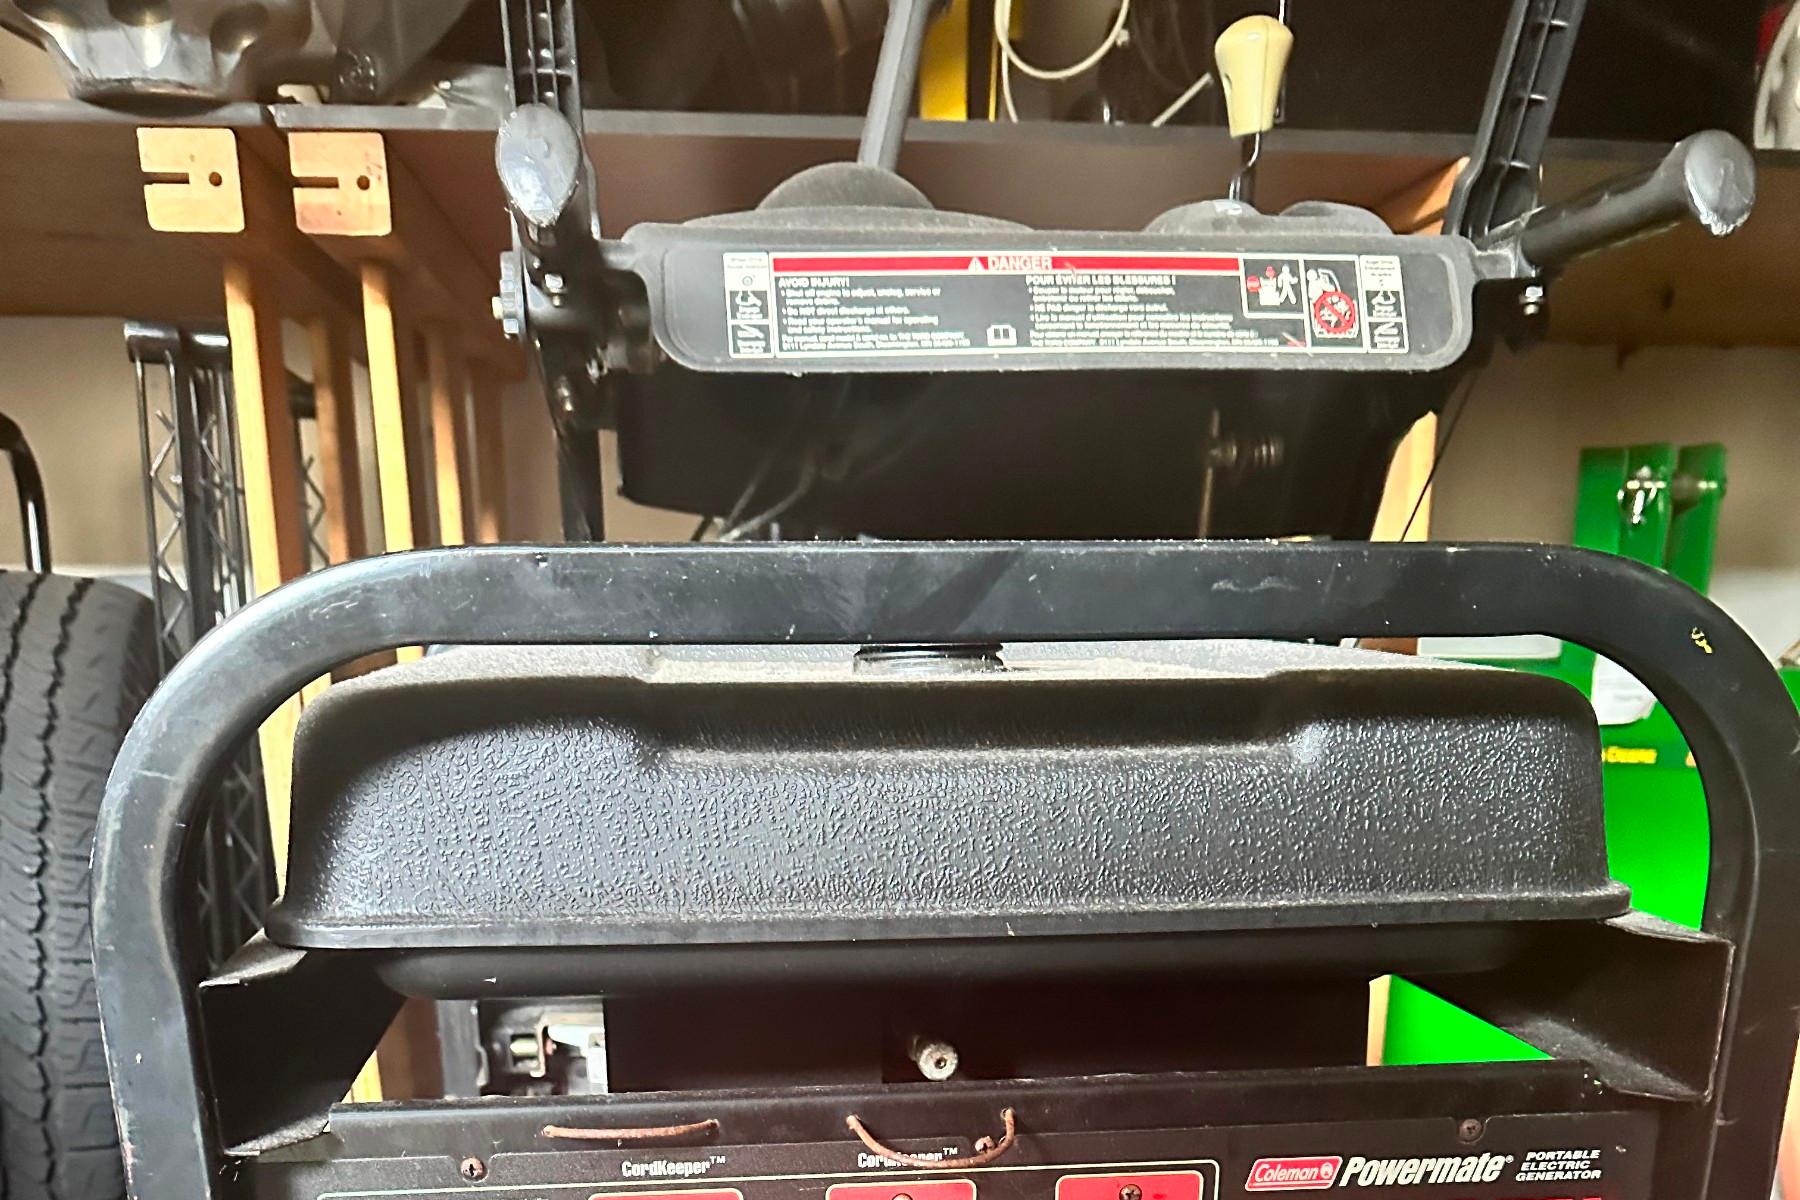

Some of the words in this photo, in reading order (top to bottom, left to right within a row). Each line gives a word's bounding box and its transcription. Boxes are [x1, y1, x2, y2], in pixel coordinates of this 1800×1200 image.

[988, 256, 1052, 271] DANGER
[779, 277, 809, 288] AVOID
[811, 277, 850, 288] INJURY!
[1026, 275, 1054, 285] POUR
[1091, 275, 1111, 285] LES
[1526, 1150, 1601, 1161] PORTABLE
[1521, 1160, 1591, 1171] ELECTRIC
[1255, 1163, 1318, 1183] Coleman
[1516, 1170, 1601, 1182] GENERATOR
